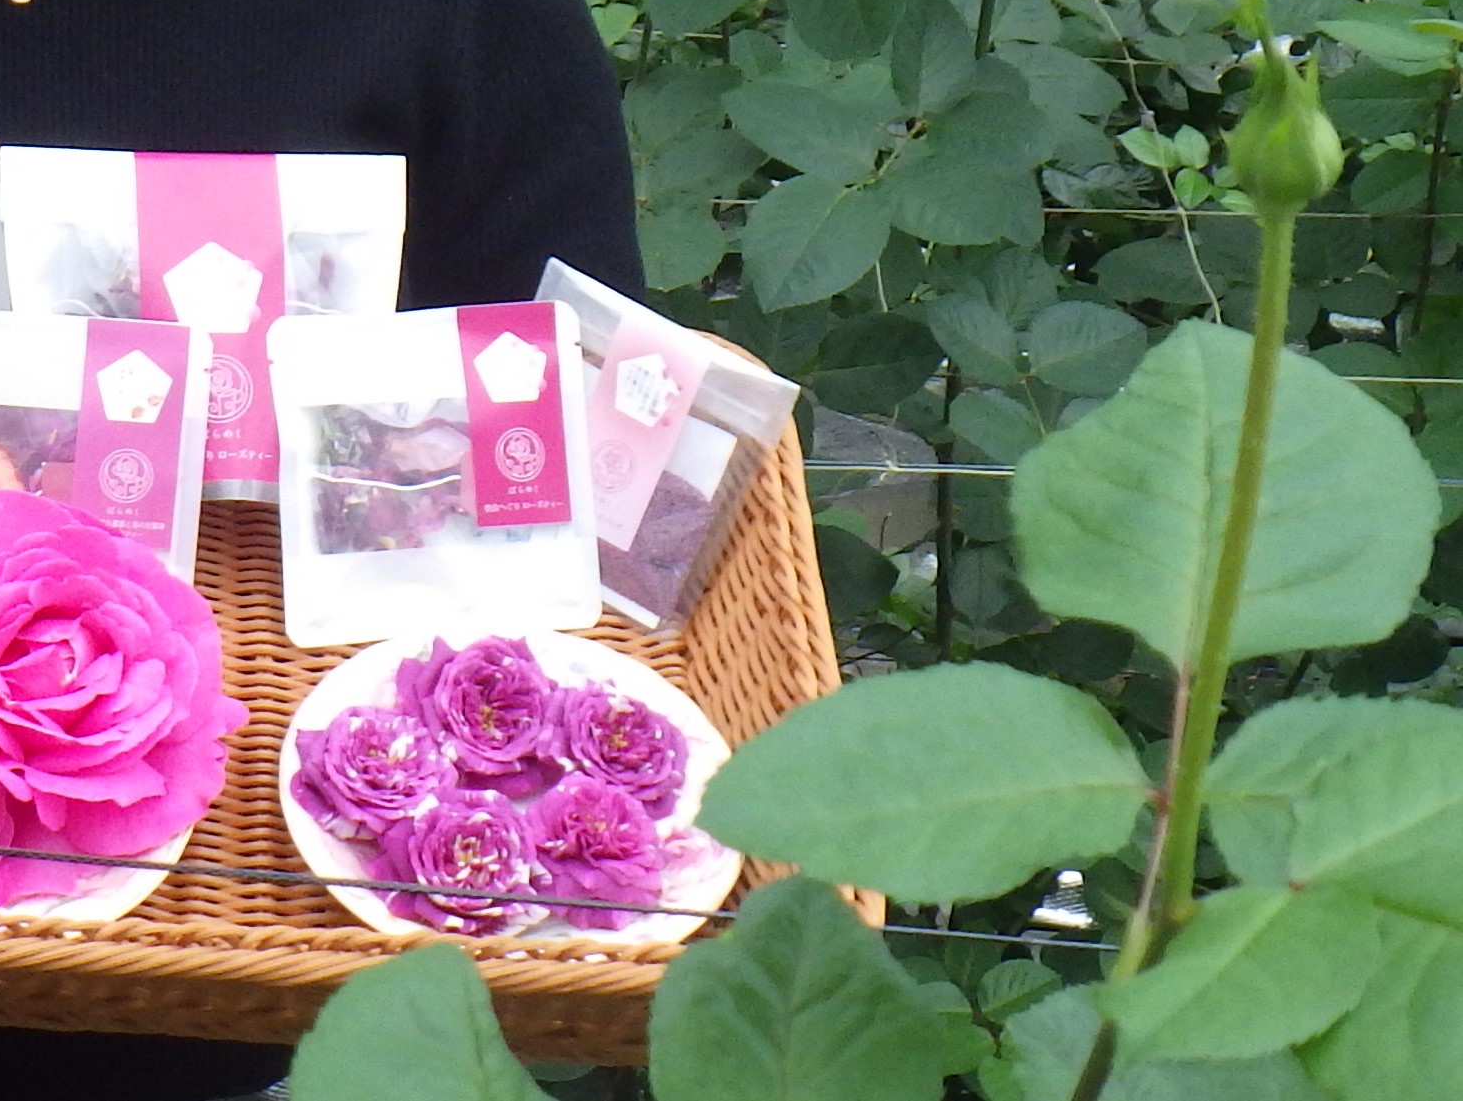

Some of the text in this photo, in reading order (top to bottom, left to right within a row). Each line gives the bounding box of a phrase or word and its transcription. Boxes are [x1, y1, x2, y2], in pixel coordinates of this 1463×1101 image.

[218, 449, 273, 460] ローズティー
